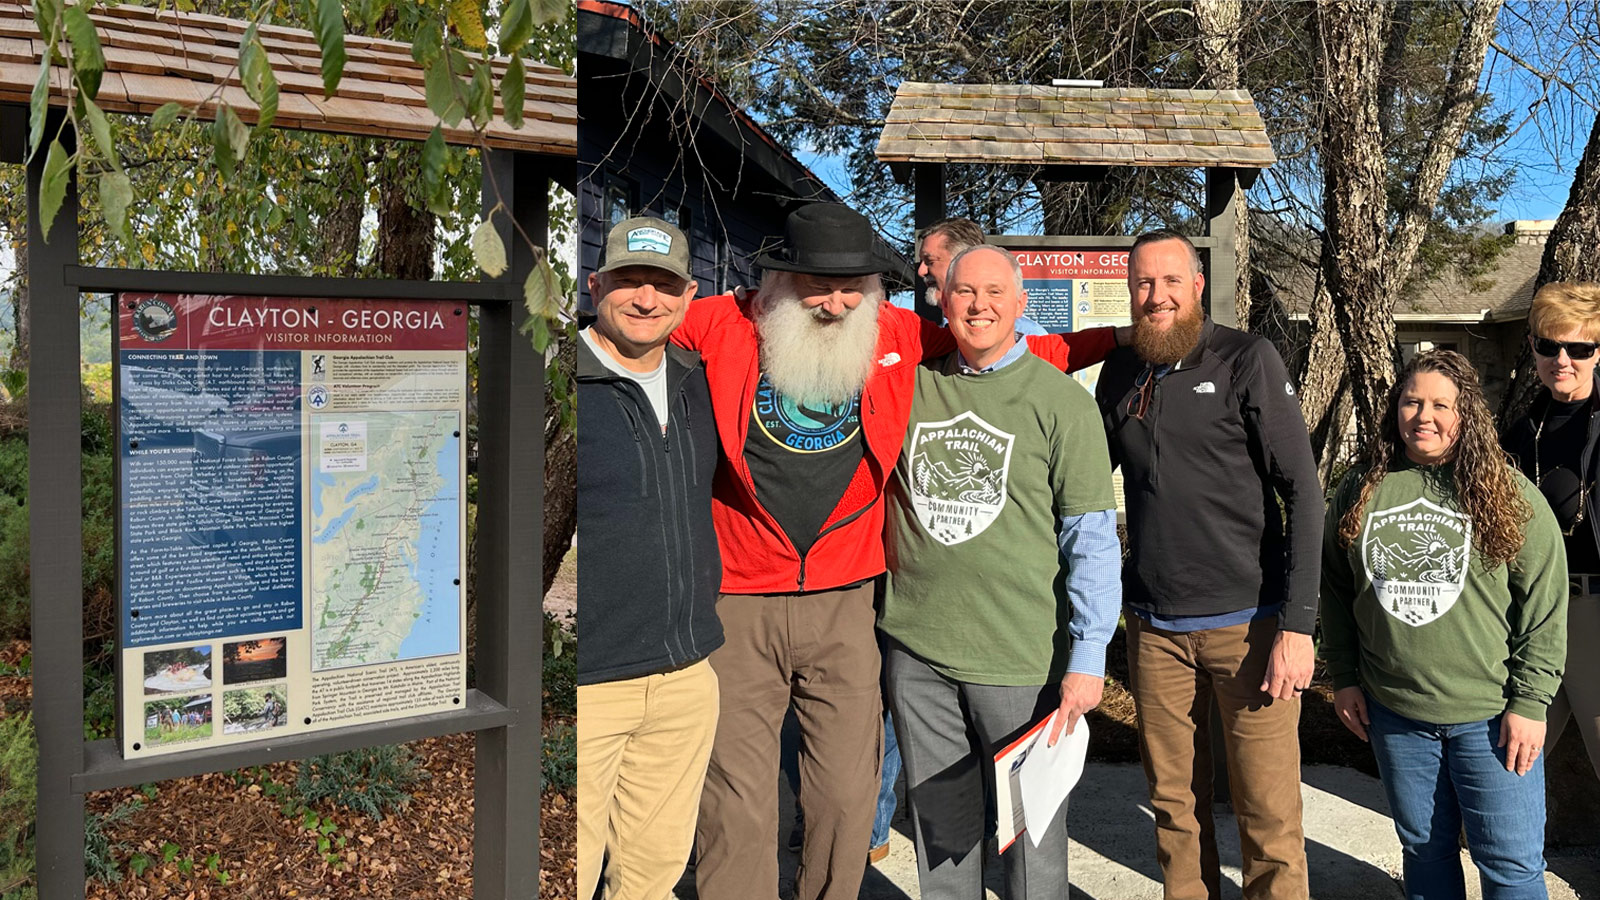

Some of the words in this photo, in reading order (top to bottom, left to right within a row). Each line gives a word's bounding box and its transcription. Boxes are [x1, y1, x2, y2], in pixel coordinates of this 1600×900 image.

[1016, 254, 1084, 266] CLAYTON
[209, 306, 318, 328] CLAYTON
[342, 310, 444, 329] GEORGIA
[266, 333, 310, 342] VISITOR
[314, 334, 392, 343] INFORMATION
[786, 430, 846, 450] GEORGIA
[920, 428, 1005, 454] APPALACHIAN
[945, 441, 980, 452] TRAIL
[928, 502, 979, 516] COMMUNITY
[936, 515, 965, 526] PARTNER
[1373, 513, 1464, 533] APPALACHIAN
[1398, 523, 1437, 533] TRAIL
[1388, 585, 1440, 596] COMMUNITY
[1400, 597, 1430, 606] PARTNER
